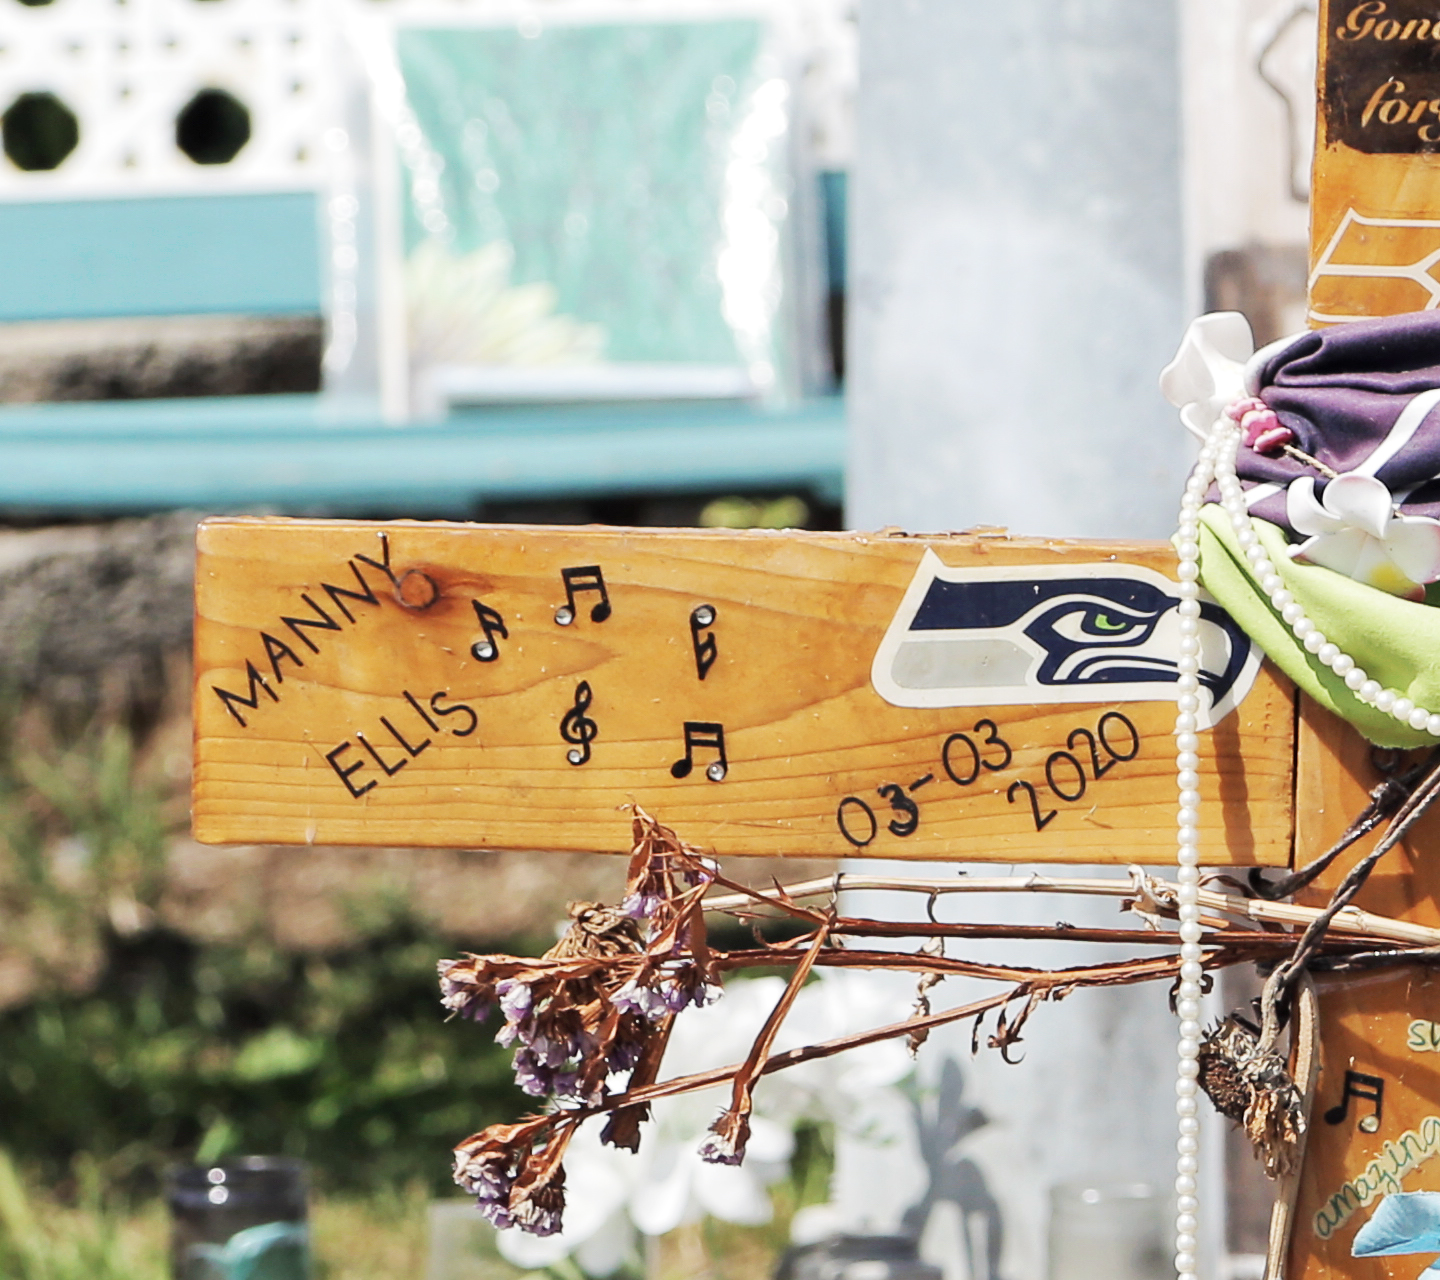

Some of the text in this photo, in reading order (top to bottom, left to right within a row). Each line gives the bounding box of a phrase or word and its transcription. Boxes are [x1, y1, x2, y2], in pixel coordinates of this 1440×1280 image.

[211, 533, 401, 728] MANNY
[325, 691, 478, 799] ELLIS
[836, 718, 1012, 846] 03-03
[1007, 711, 1139, 831] 2020
